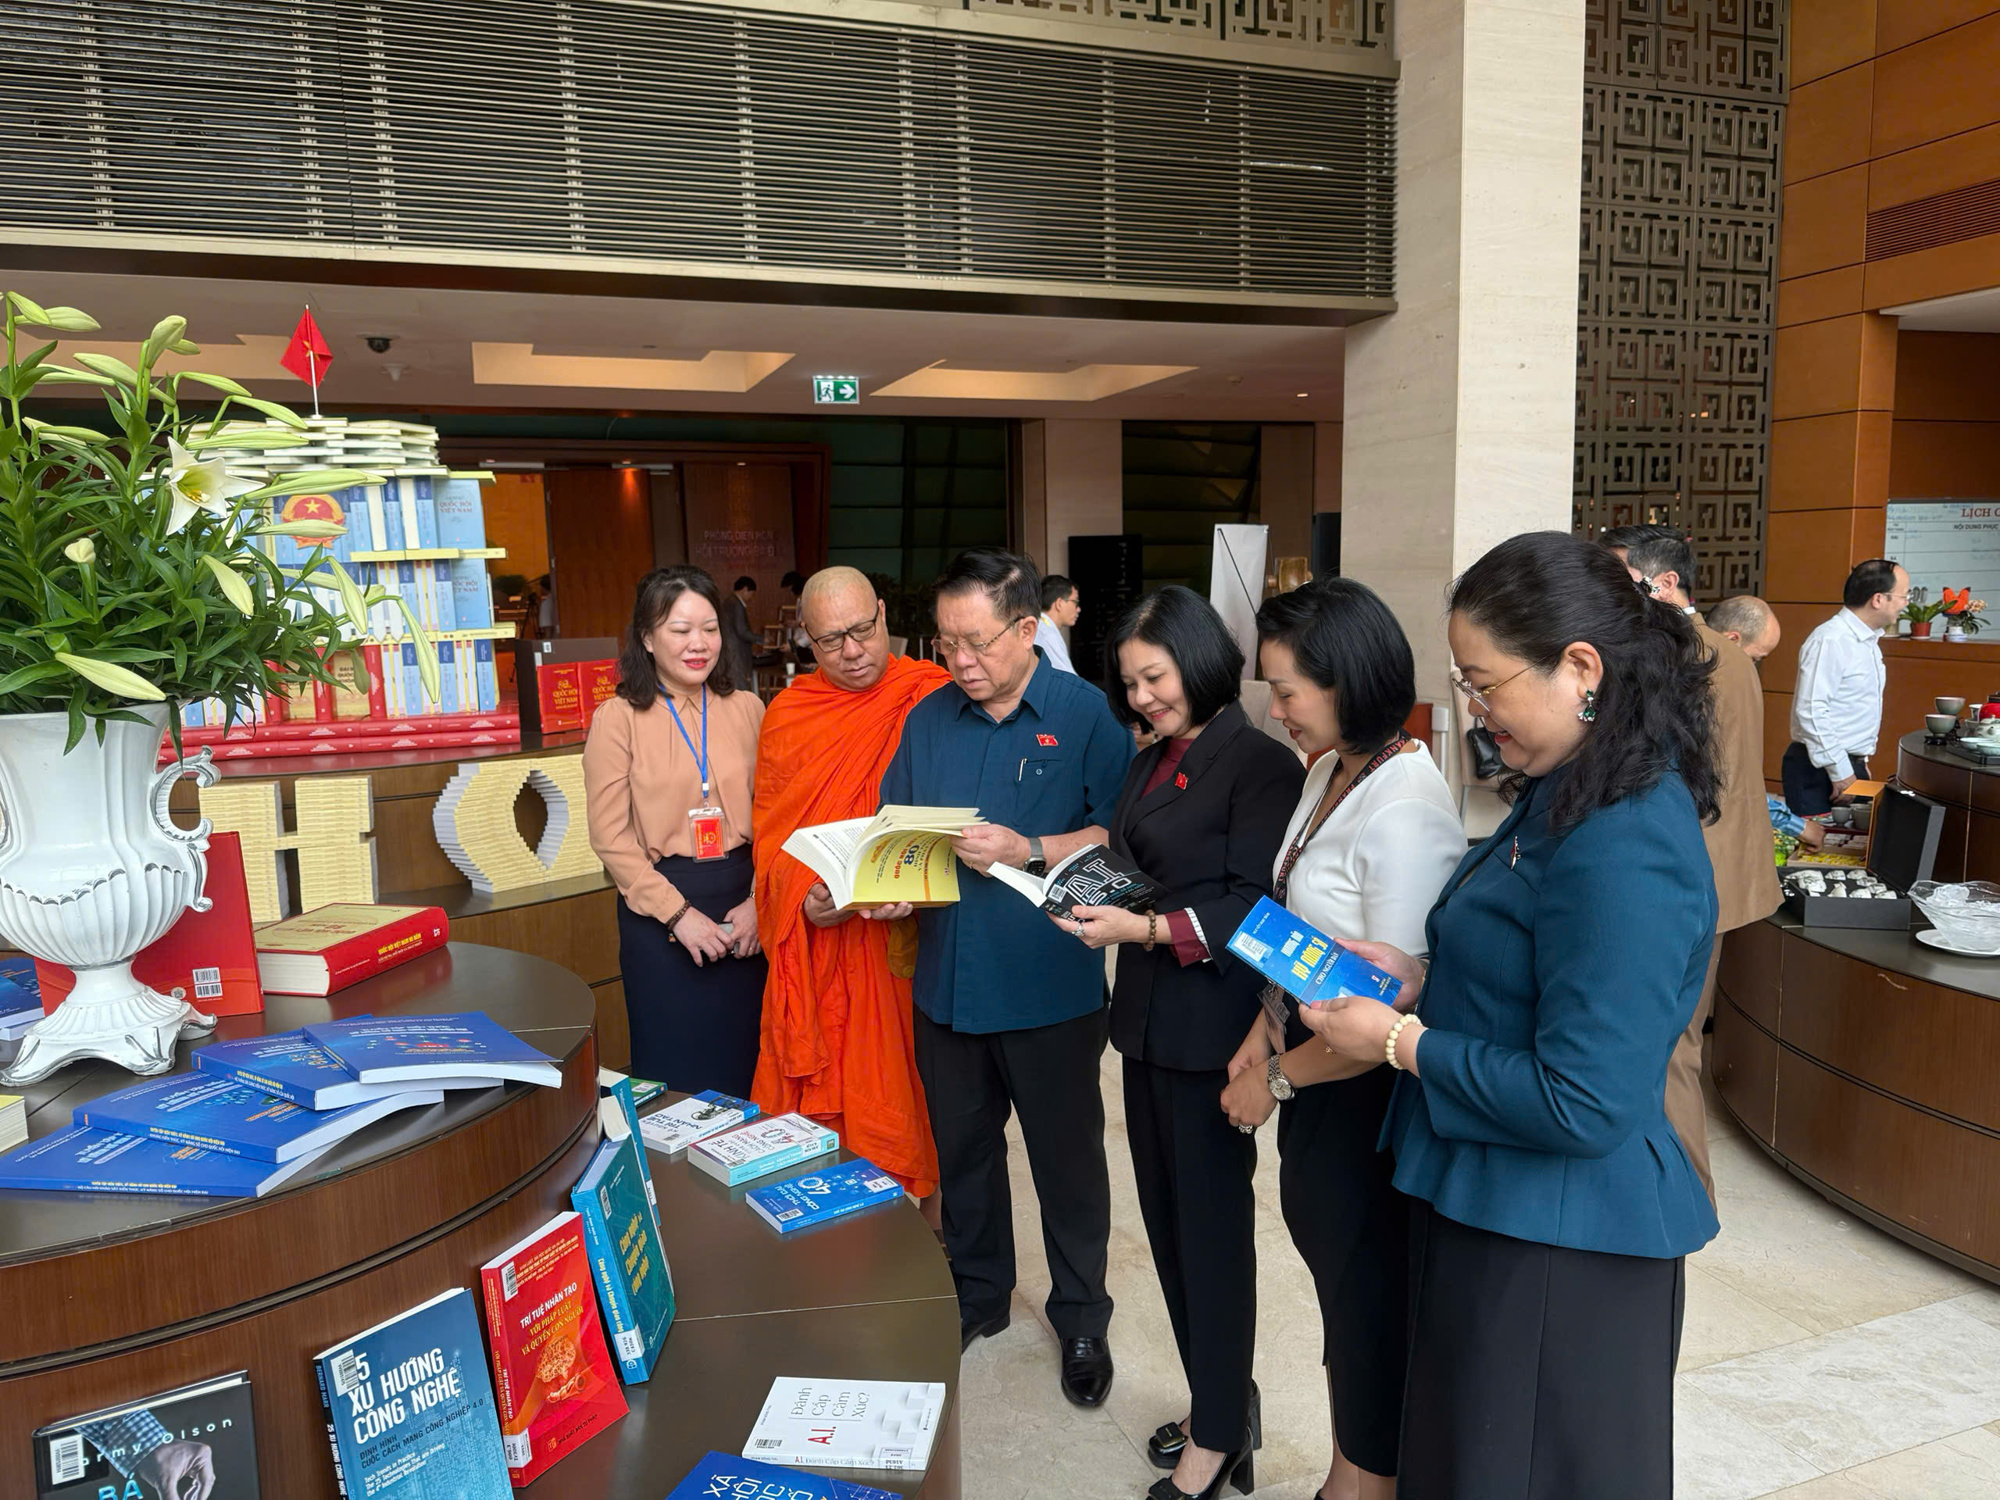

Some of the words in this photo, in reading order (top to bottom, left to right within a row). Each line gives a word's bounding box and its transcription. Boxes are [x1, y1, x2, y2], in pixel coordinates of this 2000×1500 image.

[1962, 508, 1990, 519] LỊCH
[904, 845, 919, 865] 80
[520, 1314, 532, 1329] TRÍ
[531, 1303, 545, 1319] TUỆ
[544, 1290, 564, 1311] NHÂN
[563, 1282, 577, 1297] TẠO
[551, 1320, 564, 1335] CON
[354, 1352, 371, 1381] 5
[347, 1381, 374, 1417] XU
[380, 1348, 445, 1400] HƯỚNG
[353, 1397, 406, 1445] CÔNG
[410, 1367, 462, 1416] NGHỆ
[790, 1386, 812, 1416] Đánh
[831, 1391, 851, 1417] Cảm
[851, 1391, 871, 1418] Xúc?
[81, 1441, 143, 1467] army
[162, 1417, 232, 1444] Olson
[360, 1446, 378, 1462] ĐỊNH
[379, 1434, 397, 1450] HÌNH
[361, 1455, 381, 1470] CUỘC
[382, 1444, 401, 1460] CÁCH
[403, 1432, 424, 1448] MẠNG
[425, 1420, 444, 1436] CÔNG
[473, 1398, 484, 1410] 4.0
[807, 1426, 837, 1445] A.I.
[98, 1472, 144, 1500] BÁ
[702, 1474, 738, 1498] XÃ
